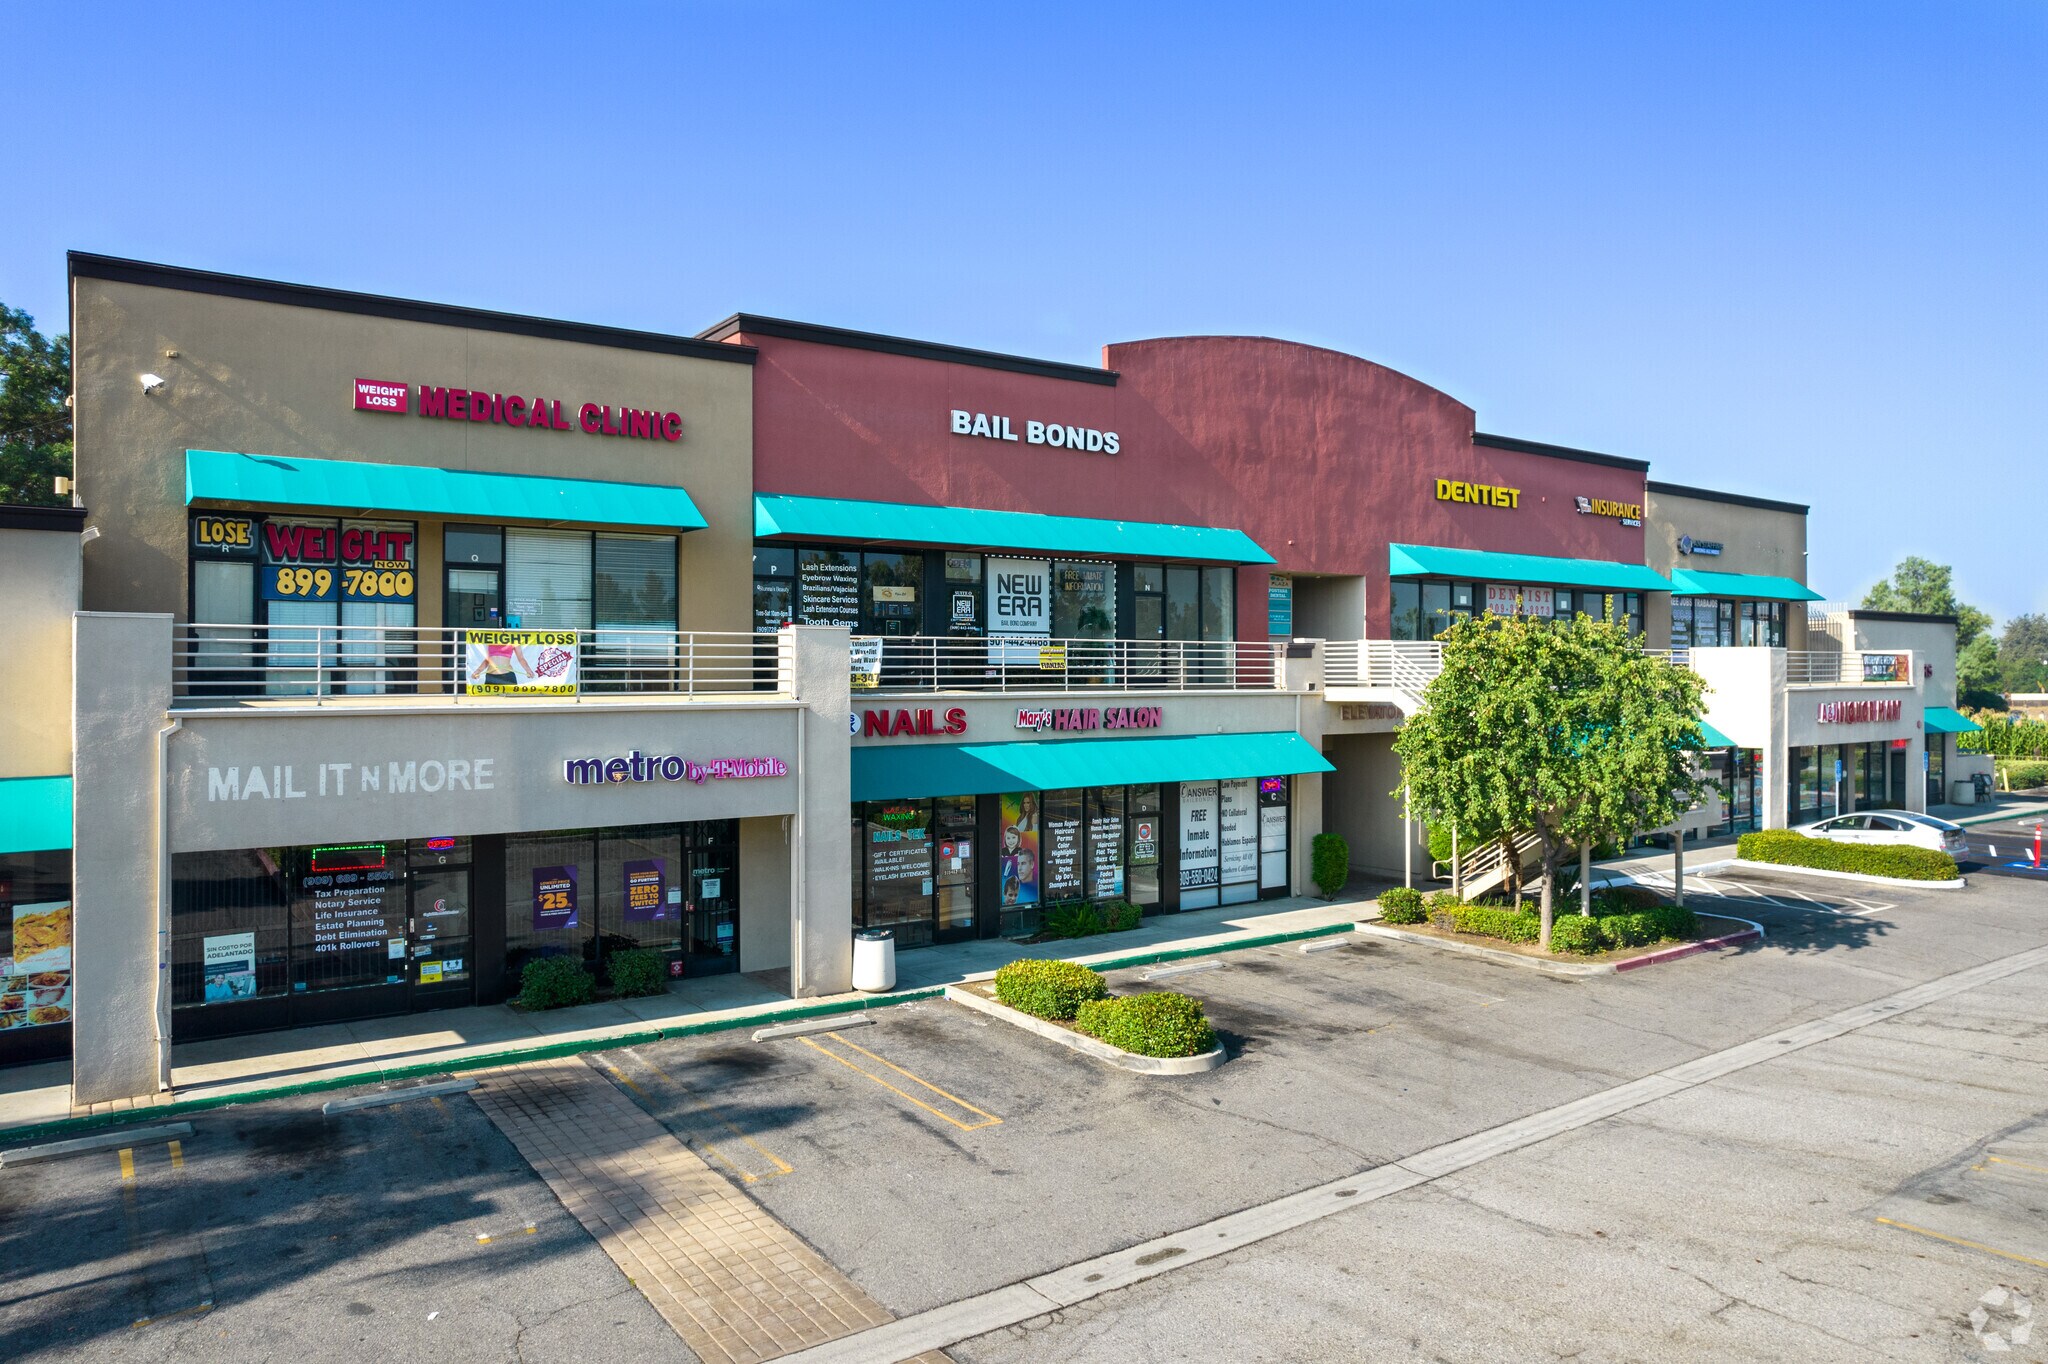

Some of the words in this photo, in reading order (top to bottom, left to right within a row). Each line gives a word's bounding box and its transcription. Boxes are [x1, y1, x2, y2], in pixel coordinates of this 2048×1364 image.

[358, 384, 405, 397] WEIGHT
[366, 395, 397, 407] LOSS
[418, 385, 572, 430] MEDICAL
[578, 402, 682, 442] CLINIC
[951, 409, 1018, 441] BAIL
[1026, 420, 1120, 455] BONDS
[1435, 479, 1520, 508] DENTIST
[1591, 499, 1641, 519] INSURANCE
[200, 520, 250, 545] LOSE
[264, 523, 413, 563] WEIGHT
[222, 545, 229, 553] R
[471, 554, 479, 562] Q
[376, 561, 408, 569] NOW
[771, 565, 777, 574] P
[802, 563, 818, 571] Lash
[820, 564, 857, 572] Extensions
[802, 574, 832, 583] Eyebrow
[833, 575, 858, 584] Waxing
[998, 574, 1042, 594] NEW
[803, 595, 830, 603] Skincare
[832, 596, 858, 604] Services
[1695, 599, 1718, 608] TRABAJOS
[803, 605, 815, 613] Lash
[816, 606, 839, 614] Extension
[839, 606, 858, 614] Courses
[998, 596, 1042, 616] ERA
[804, 618, 830, 626] Tooth
[832, 618, 859, 628] Gems
[470, 632, 531, 645] WEIGHT
[536, 633, 575, 645] LOSS
[539, 653, 567, 671] SPECIAL
[471, 685, 506, 694] (909)
[512, 684, 574, 694] 899-7800
[865, 708, 968, 737] NAILS
[1016, 708, 1051, 732] Mary's
[1052, 708, 1100, 730] HAIR
[1103, 707, 1162, 729] SALON
[564, 750, 686, 784] metro
[686, 761, 709, 784] by
[208, 765, 306, 801] MAIL
[319, 763, 351, 796] IT
[361, 766, 379, 791] N
[389, 759, 494, 793] MORE
[1187, 787, 1217, 798] ANSWER
[1271, 792, 1276, 800] C
[883, 813, 915, 821] WAXING
[1191, 809, 1207, 822] FREE
[873, 830, 901, 842] NAILS
[906, 828, 926, 840] TEK
[1187, 829, 1209, 841] Inmate
[427, 839, 455, 849] OPEN
[889, 848, 928, 857] CERTIFICATES
[1180, 846, 1217, 861] Information
[439, 856, 446, 864] G
[693, 867, 715, 875] metro
[900, 870, 930, 878] EXTENSIONS
[303, 876, 333, 888] (909)
[334, 886, 385, 897] Preparation
[630, 885, 659, 895] ZERO
[315, 900, 345, 910] Notary
[348, 897, 381, 906] Service
[538, 892, 568, 910] $25
[630, 899, 659, 907] SWITCH
[315, 911, 332, 920] Life
[334, 909, 379, 918] Insurance
[315, 922, 344, 931] Estate
[347, 918, 385, 930] Planning
[315, 933, 336, 942] Debt
[339, 928, 388, 939] Elimination
[315, 943, 337, 952] 401k
[340, 941, 380, 950] Rollovers
[207, 949, 253, 959] ADELANTADO
